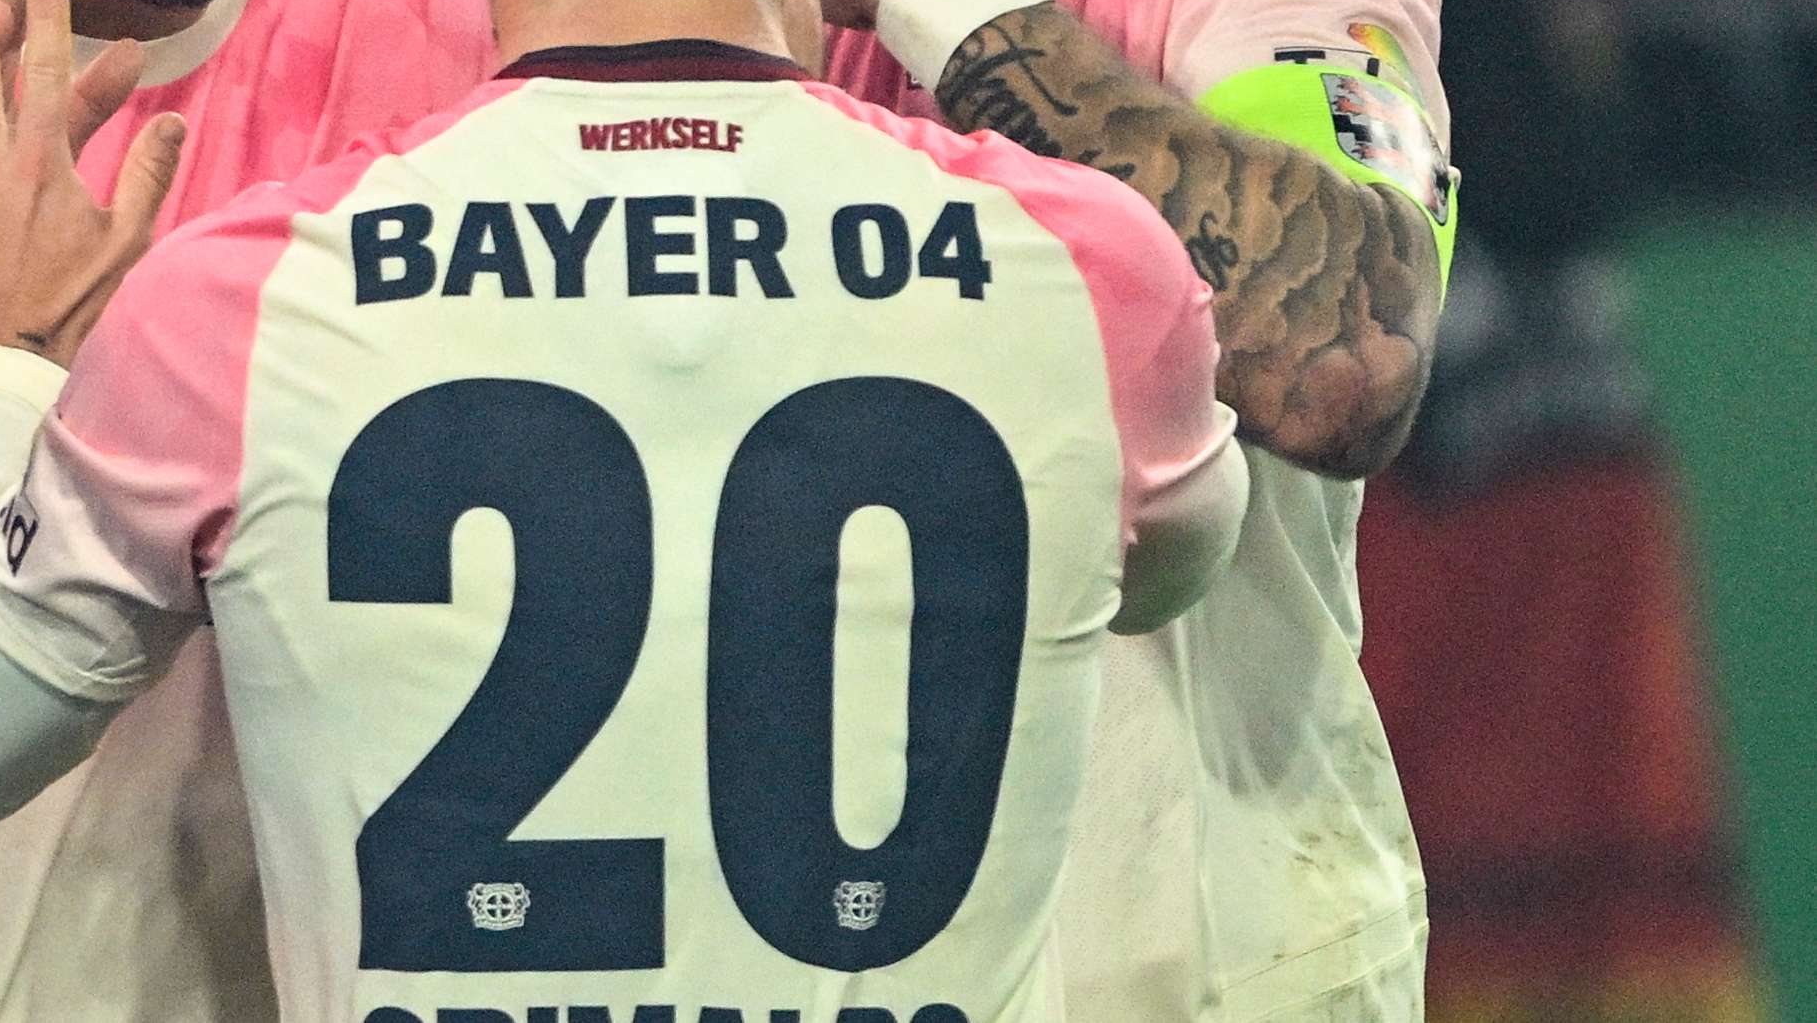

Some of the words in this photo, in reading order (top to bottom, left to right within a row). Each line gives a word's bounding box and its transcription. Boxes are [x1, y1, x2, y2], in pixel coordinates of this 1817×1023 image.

[578, 117, 743, 153] WERKSELF
[350, 195, 796, 306] BAYER
[831, 201, 993, 301] 04
[327, 376, 1030, 974] 20
